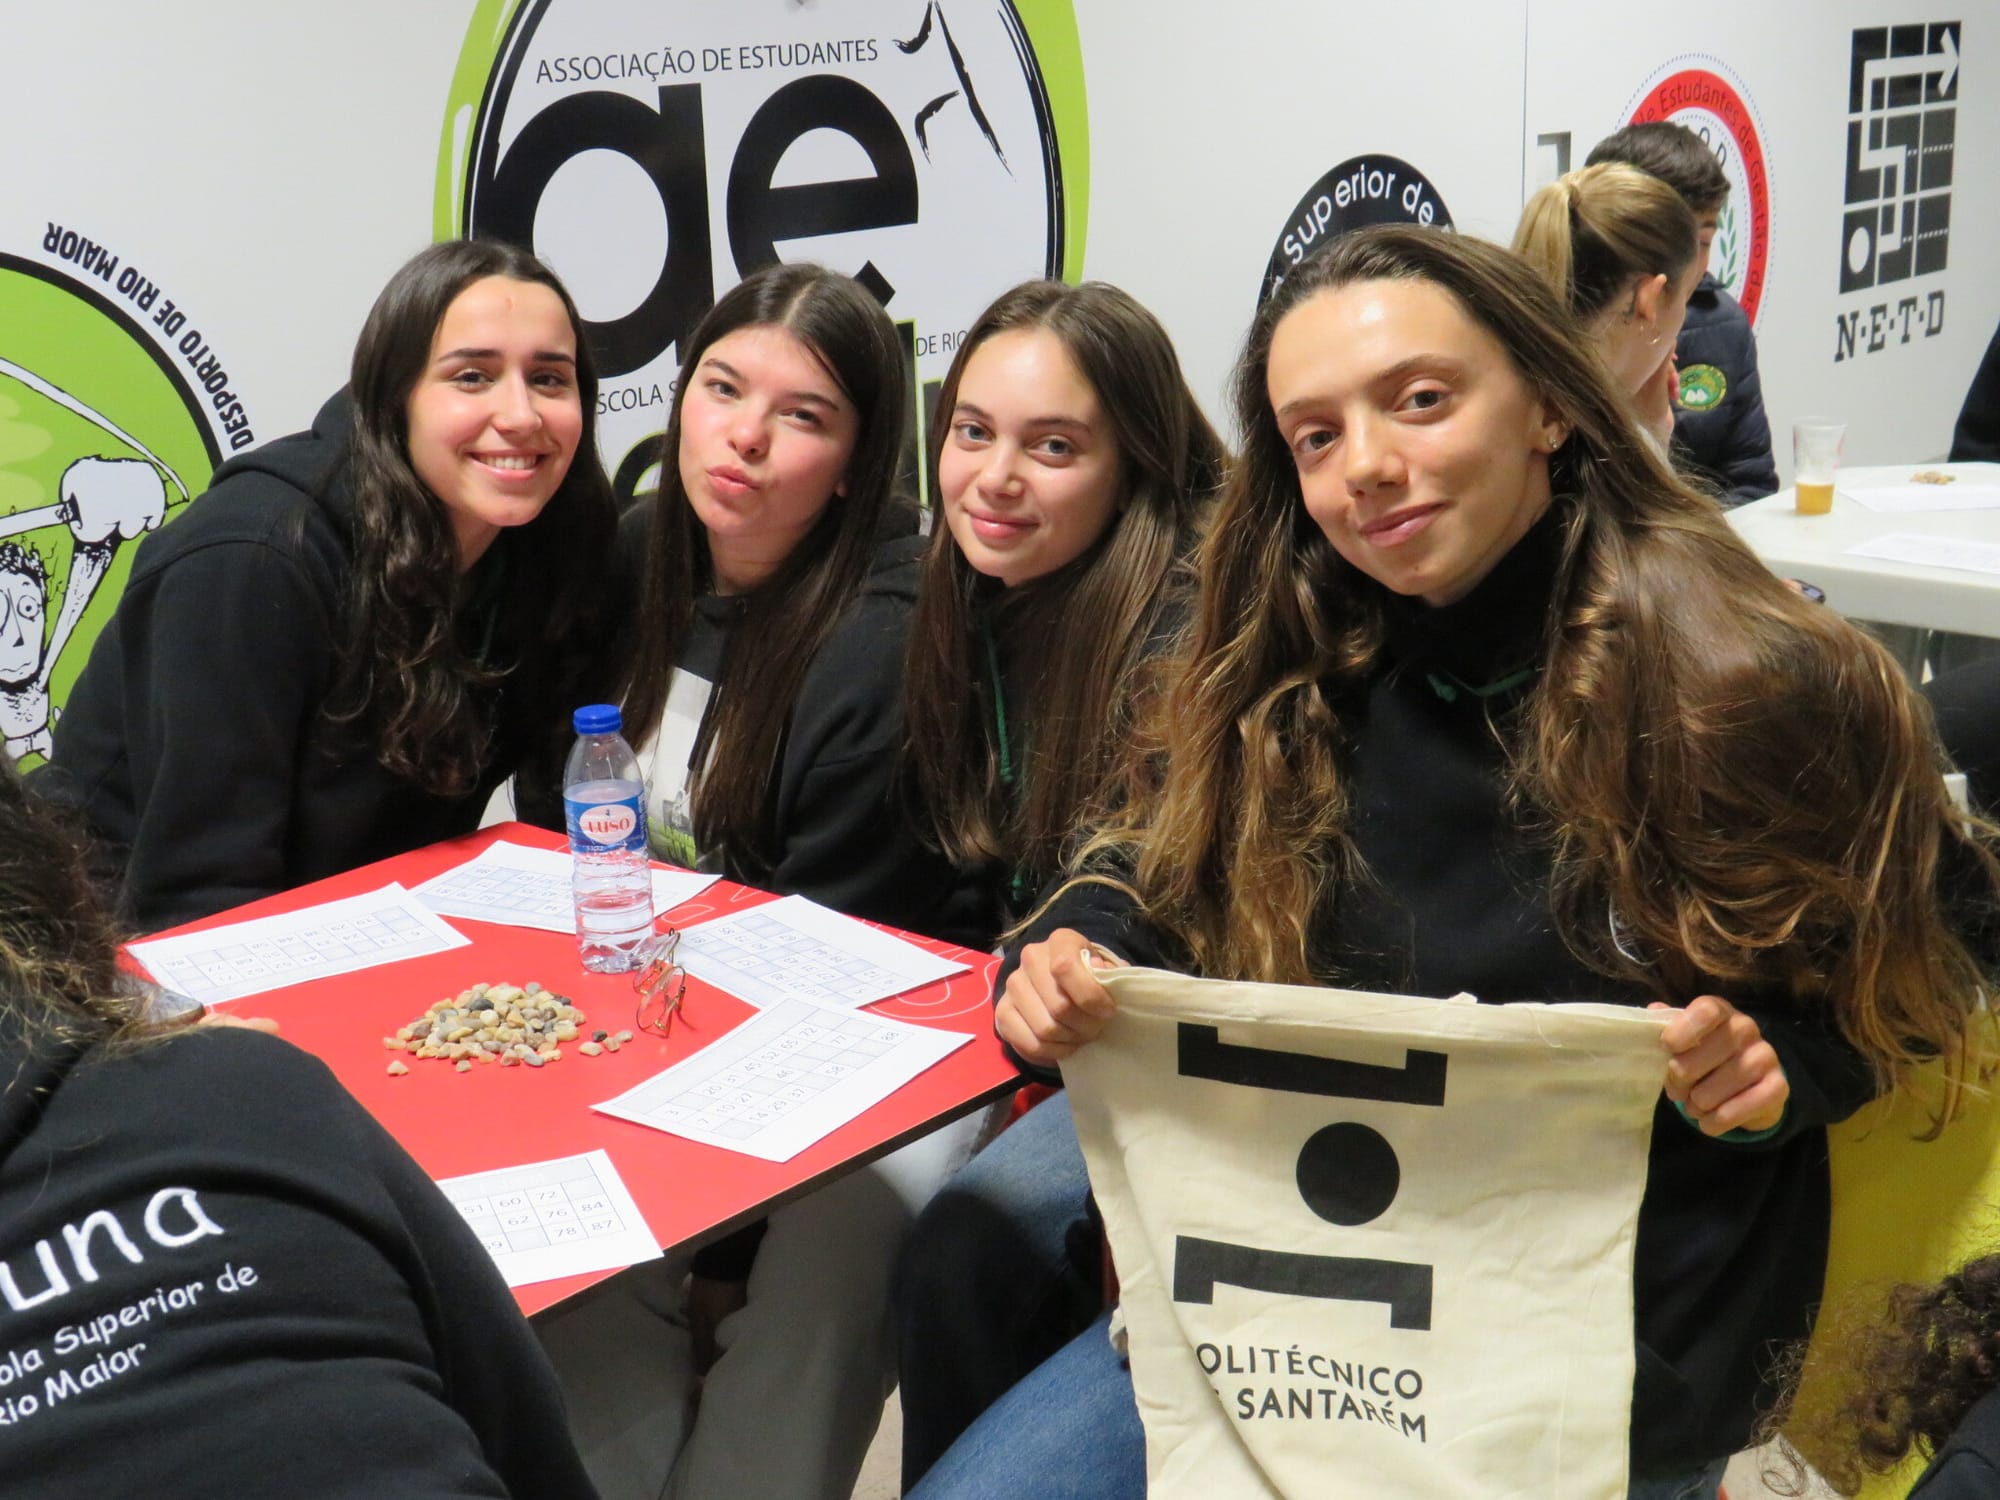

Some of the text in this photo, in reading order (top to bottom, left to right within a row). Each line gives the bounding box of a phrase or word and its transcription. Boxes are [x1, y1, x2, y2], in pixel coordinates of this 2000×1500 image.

[536, 38, 879, 85] ASSOCIAÇÃO DE ESTUDANTES
[1283, 164, 1434, 265] Superior de
[42, 221, 255, 450] DESPORTO DE RIO MAIOR
[915, 335, 937, 357] DE
[597, 383, 663, 415] SCOLA
[745, 1062, 762, 1072] 45
[761, 1050, 780, 1061] 52
[780, 1039, 799, 1049] 65
[799, 1027, 818, 1037] 72
[831, 1034, 847, 1045] 77
[464, 1190, 558, 1214] 51 60 72
[508, 1201, 603, 1226] 62 76 84
[556, 1226, 577, 1237] 78
[591, 1219, 612, 1230] 87
[54, 1280, 204, 1355] Superior
[216, 1262, 259, 1293] de
[44, 1343, 146, 1407] Maior
[1196, 1341, 1424, 1401] OLITÉCNICO
[1237, 1387, 1428, 1444] SANTARÉM
